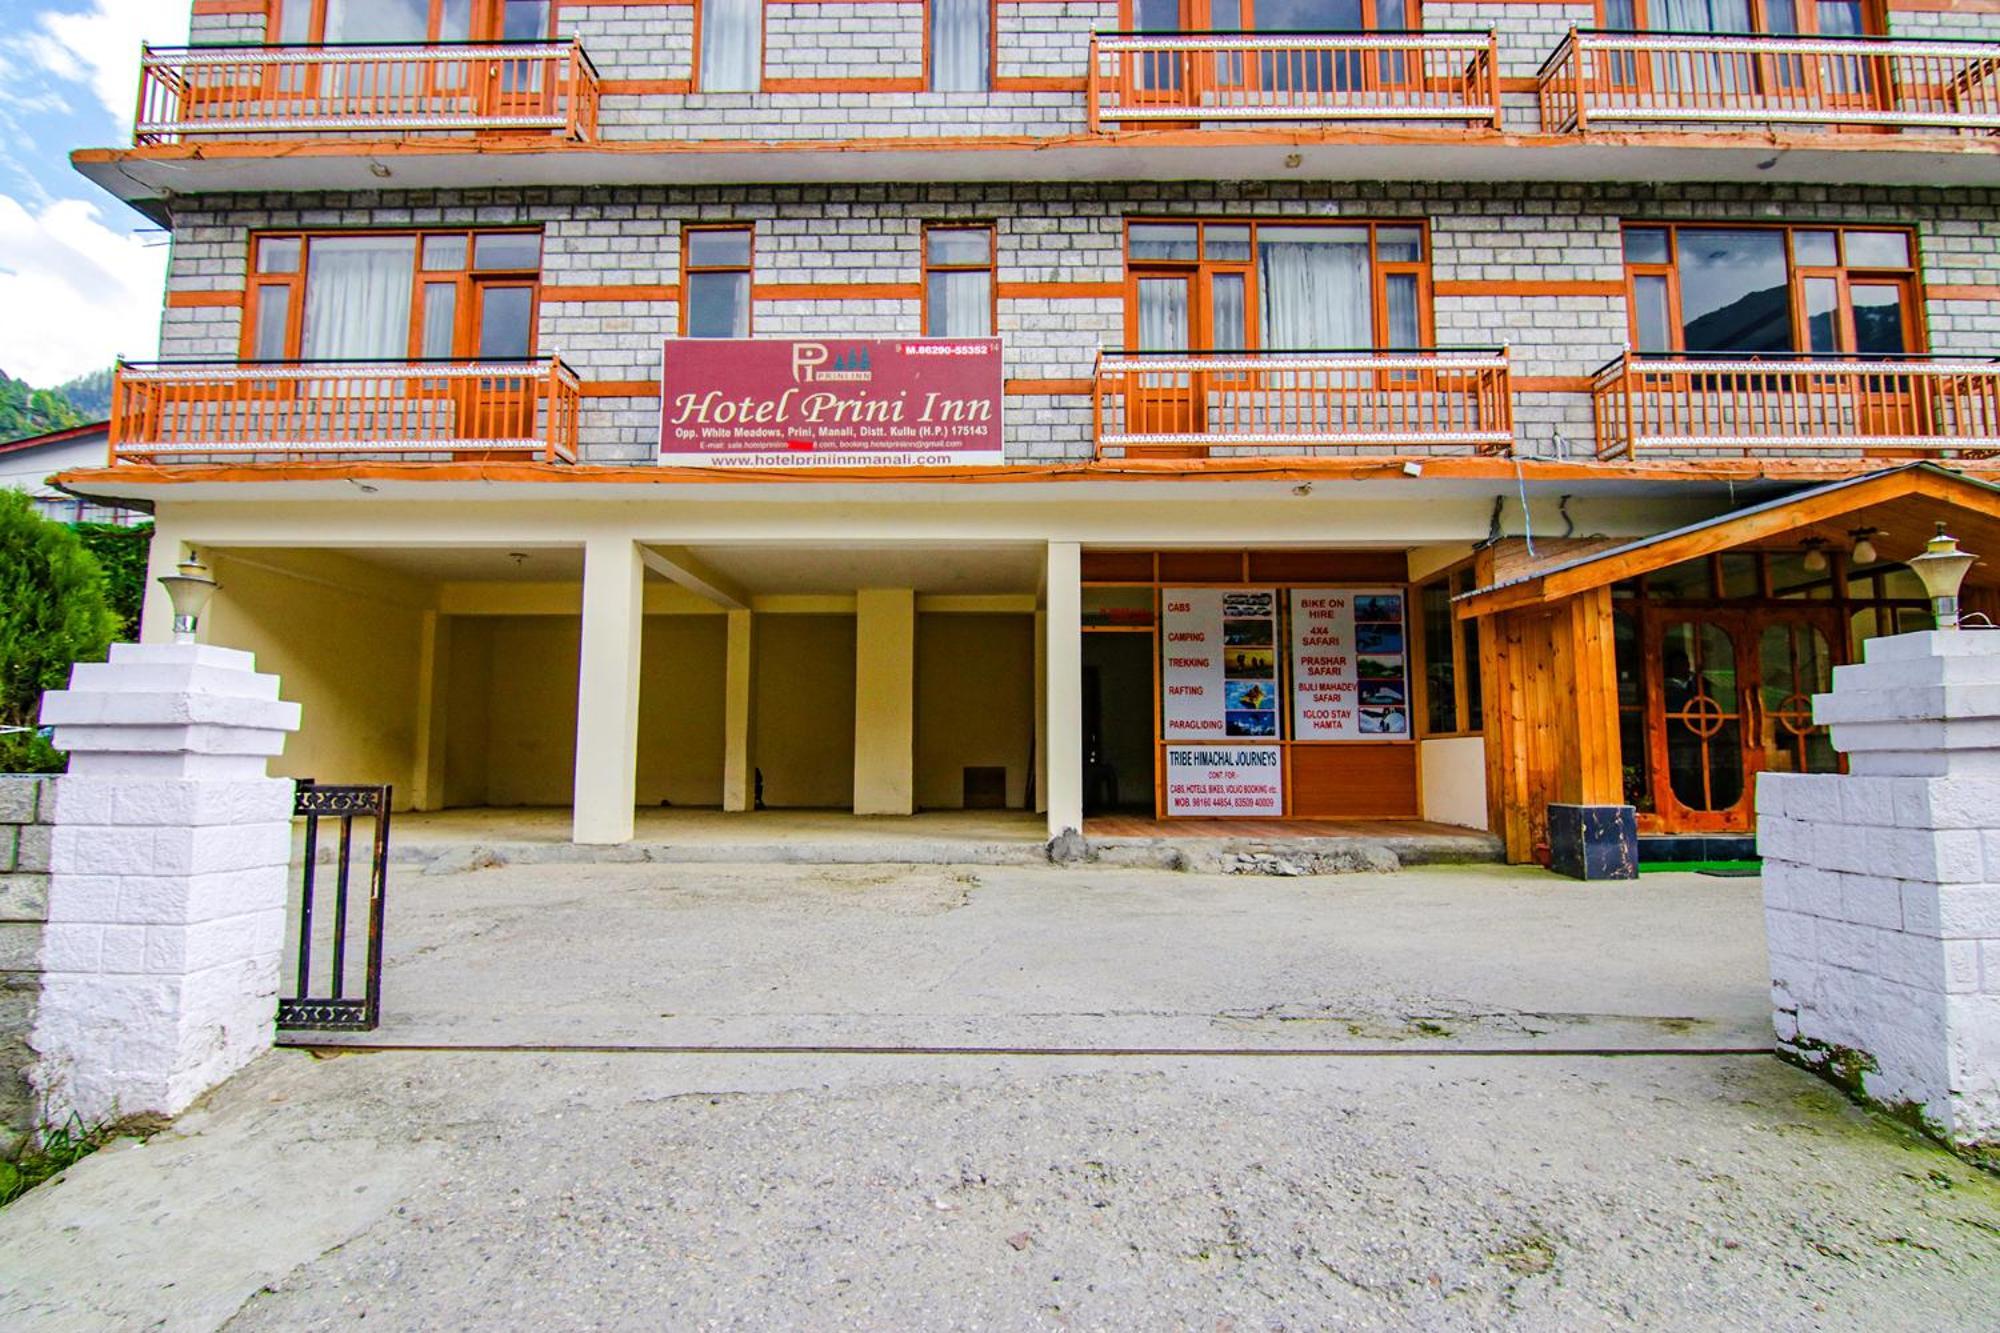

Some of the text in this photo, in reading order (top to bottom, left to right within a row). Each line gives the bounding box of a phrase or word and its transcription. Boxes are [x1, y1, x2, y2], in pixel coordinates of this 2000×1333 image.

[671, 388, 993, 424] Hotel Prini Inn
[675, 425, 989, 439] Opp. White Meadows, Prini, Manali, Distt. Kullu (H.P.) 175143
[711, 454, 952, 467] www.hotelpriniinnmanali.com
[1168, 603, 1191, 612] CABS
[1301, 599, 1345, 608] BIKE ON
[1309, 610, 1335, 619] HIRE
[1310, 626, 1329, 635] 4X4
[1168, 632, 1205, 642] CAMPING
[1302, 637, 1340, 646] SAFARI
[1169, 658, 1210, 668] TREKKING
[1301, 656, 1347, 666] PRASHAR
[1308, 667, 1341, 676] SAFARI
[1168, 686, 1204, 696] RAFTING
[1319, 682, 1357, 692] MAHADEV
[1313, 693, 1341, 702] SAFARI
[1303, 709, 1352, 719] IGLOO STAY
[1169, 720, 1224, 730] PARAGLIDING
[1313, 720, 1343, 730] HAMTA
[1170, 751, 1277, 767] TRIBE HIMACHAL JOURNEYS
